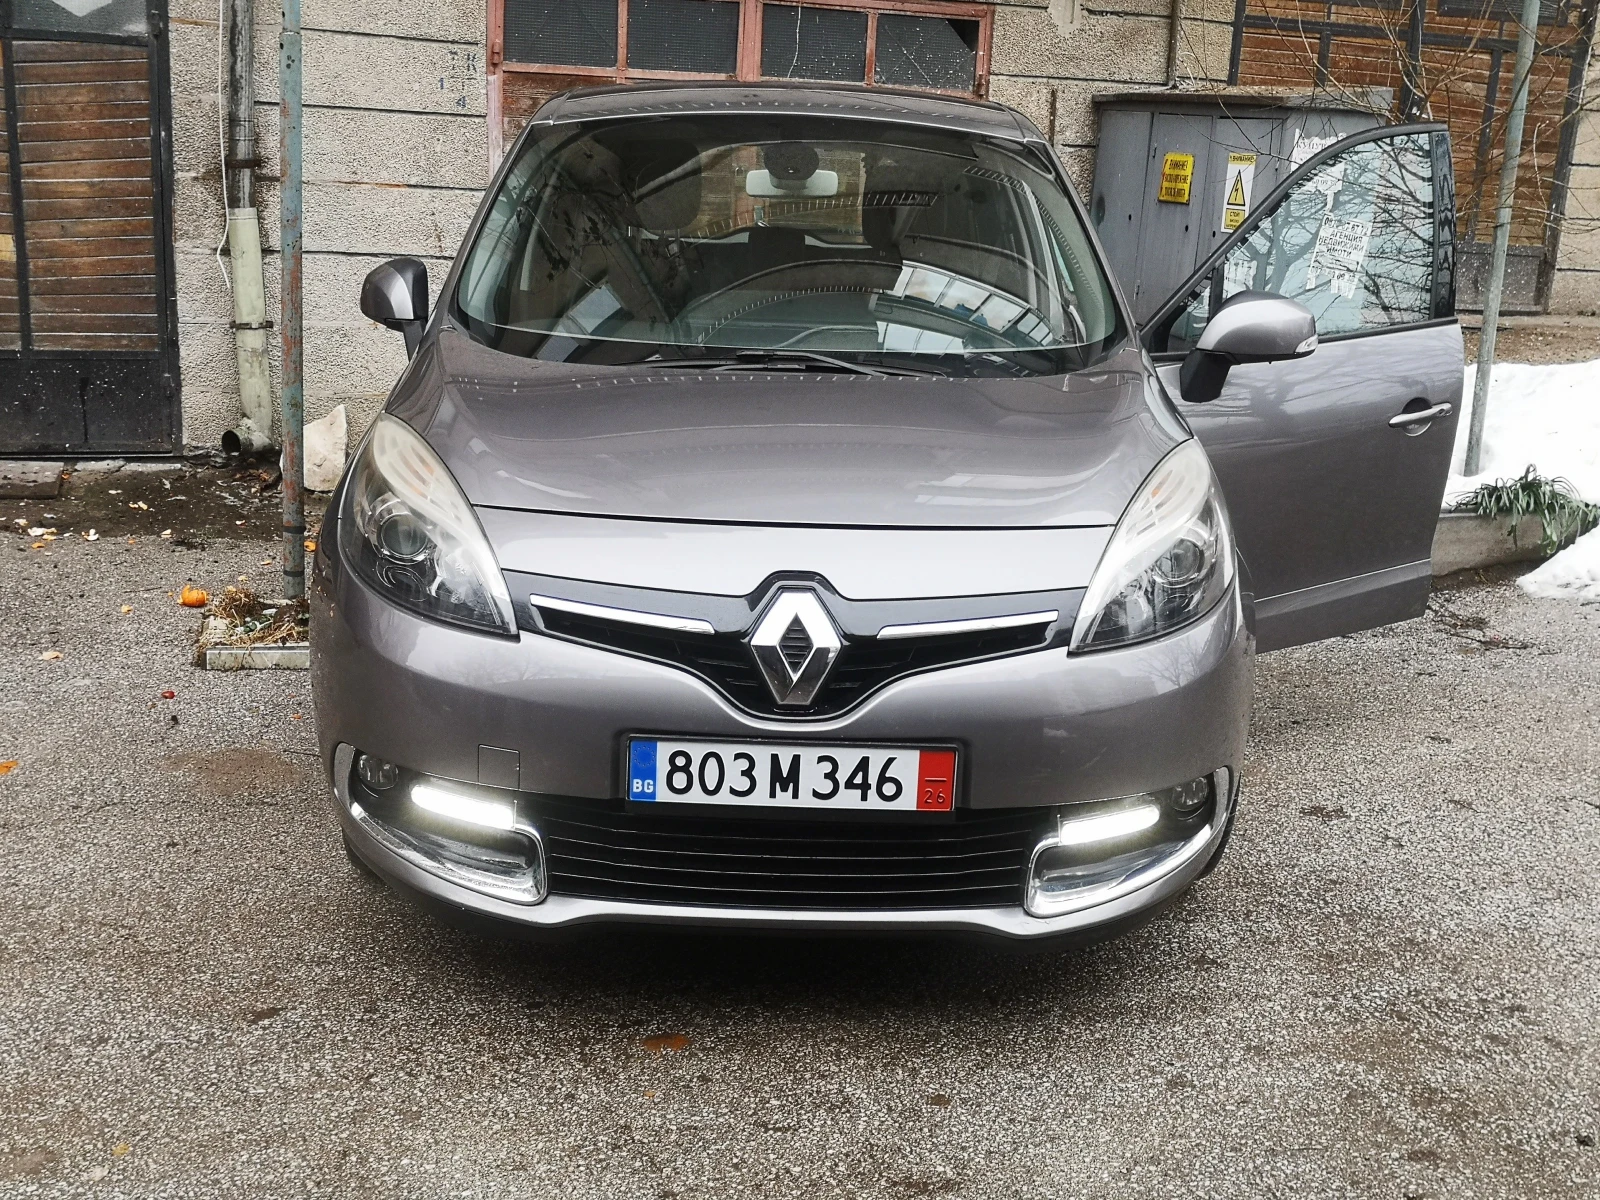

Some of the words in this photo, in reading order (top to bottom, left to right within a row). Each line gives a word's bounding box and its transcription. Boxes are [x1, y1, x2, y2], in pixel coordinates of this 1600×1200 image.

[1318, 235, 1365, 252] НЕДВИЖИМИ
[1329, 231, 1363, 243] АГЕНЦИЯ
[1326, 247, 1352, 258] ИМОТИ
[665, 749, 758, 798] 803
[768, 752, 802, 800] M
[811, 755, 904, 803] 346
[632, 778, 655, 794] BG
[923, 788, 946, 805] 26
